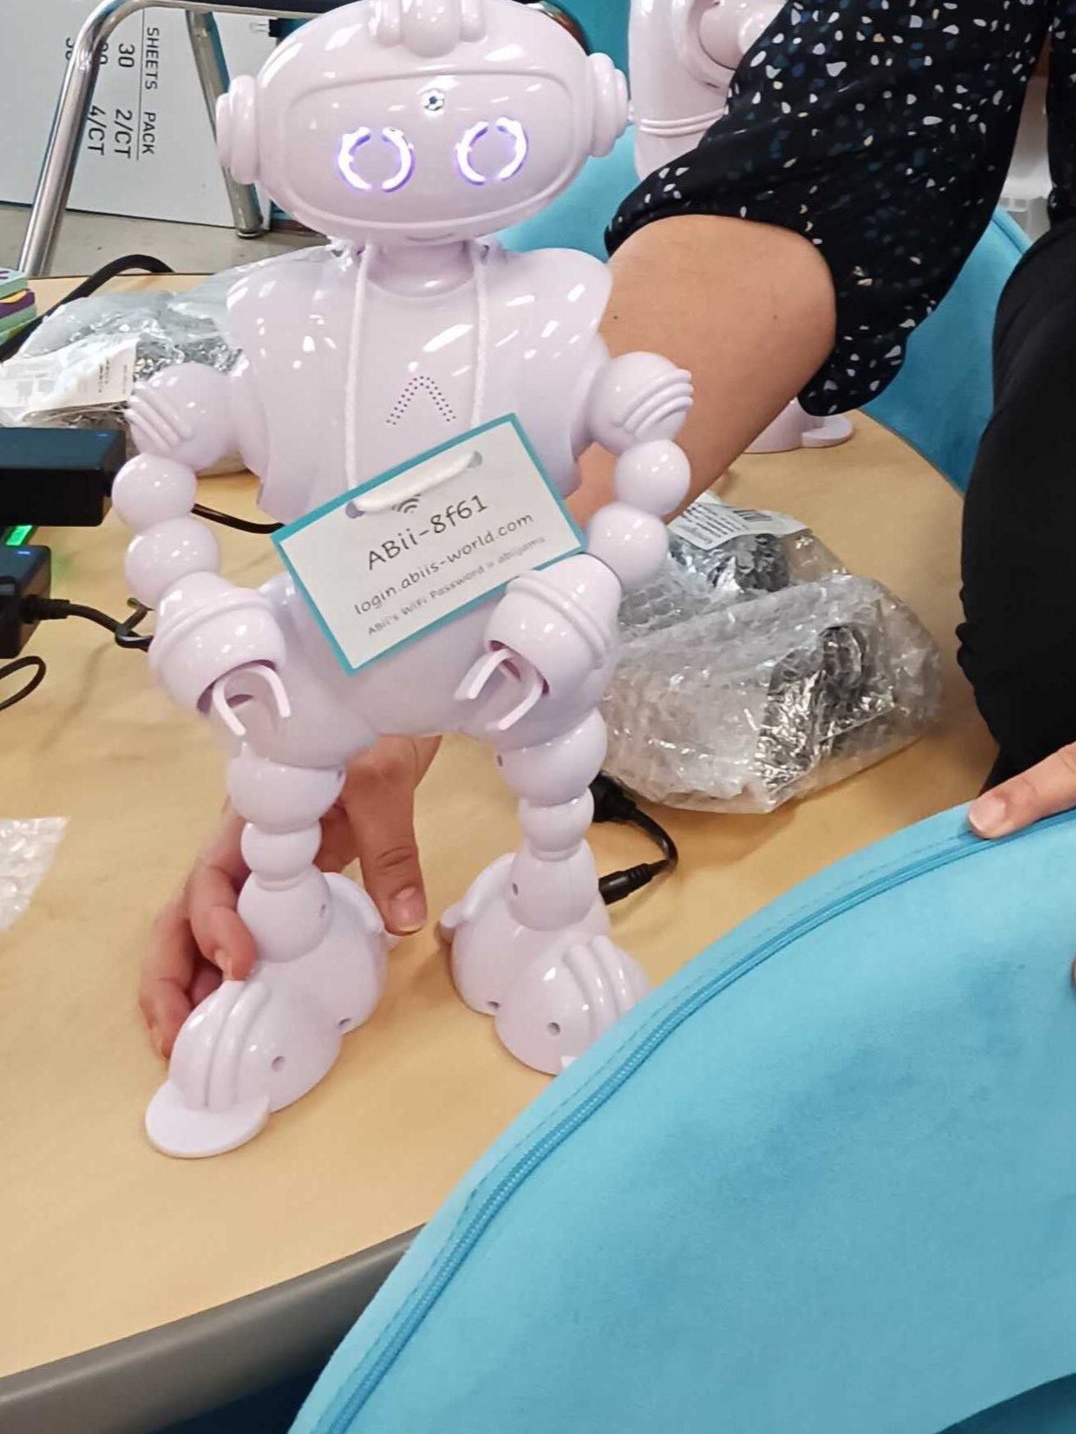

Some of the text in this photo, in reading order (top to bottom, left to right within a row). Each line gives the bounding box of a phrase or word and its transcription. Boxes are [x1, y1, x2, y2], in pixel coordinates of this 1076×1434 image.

[117, 43, 136, 68] 30
[144, 27, 160, 90] SHEETS
[87, 105, 108, 156] 4/CT
[114, 108, 134, 158] 2/CT
[142, 111, 157, 154] PACK
[367, 494, 489, 571] ABii-8f61
